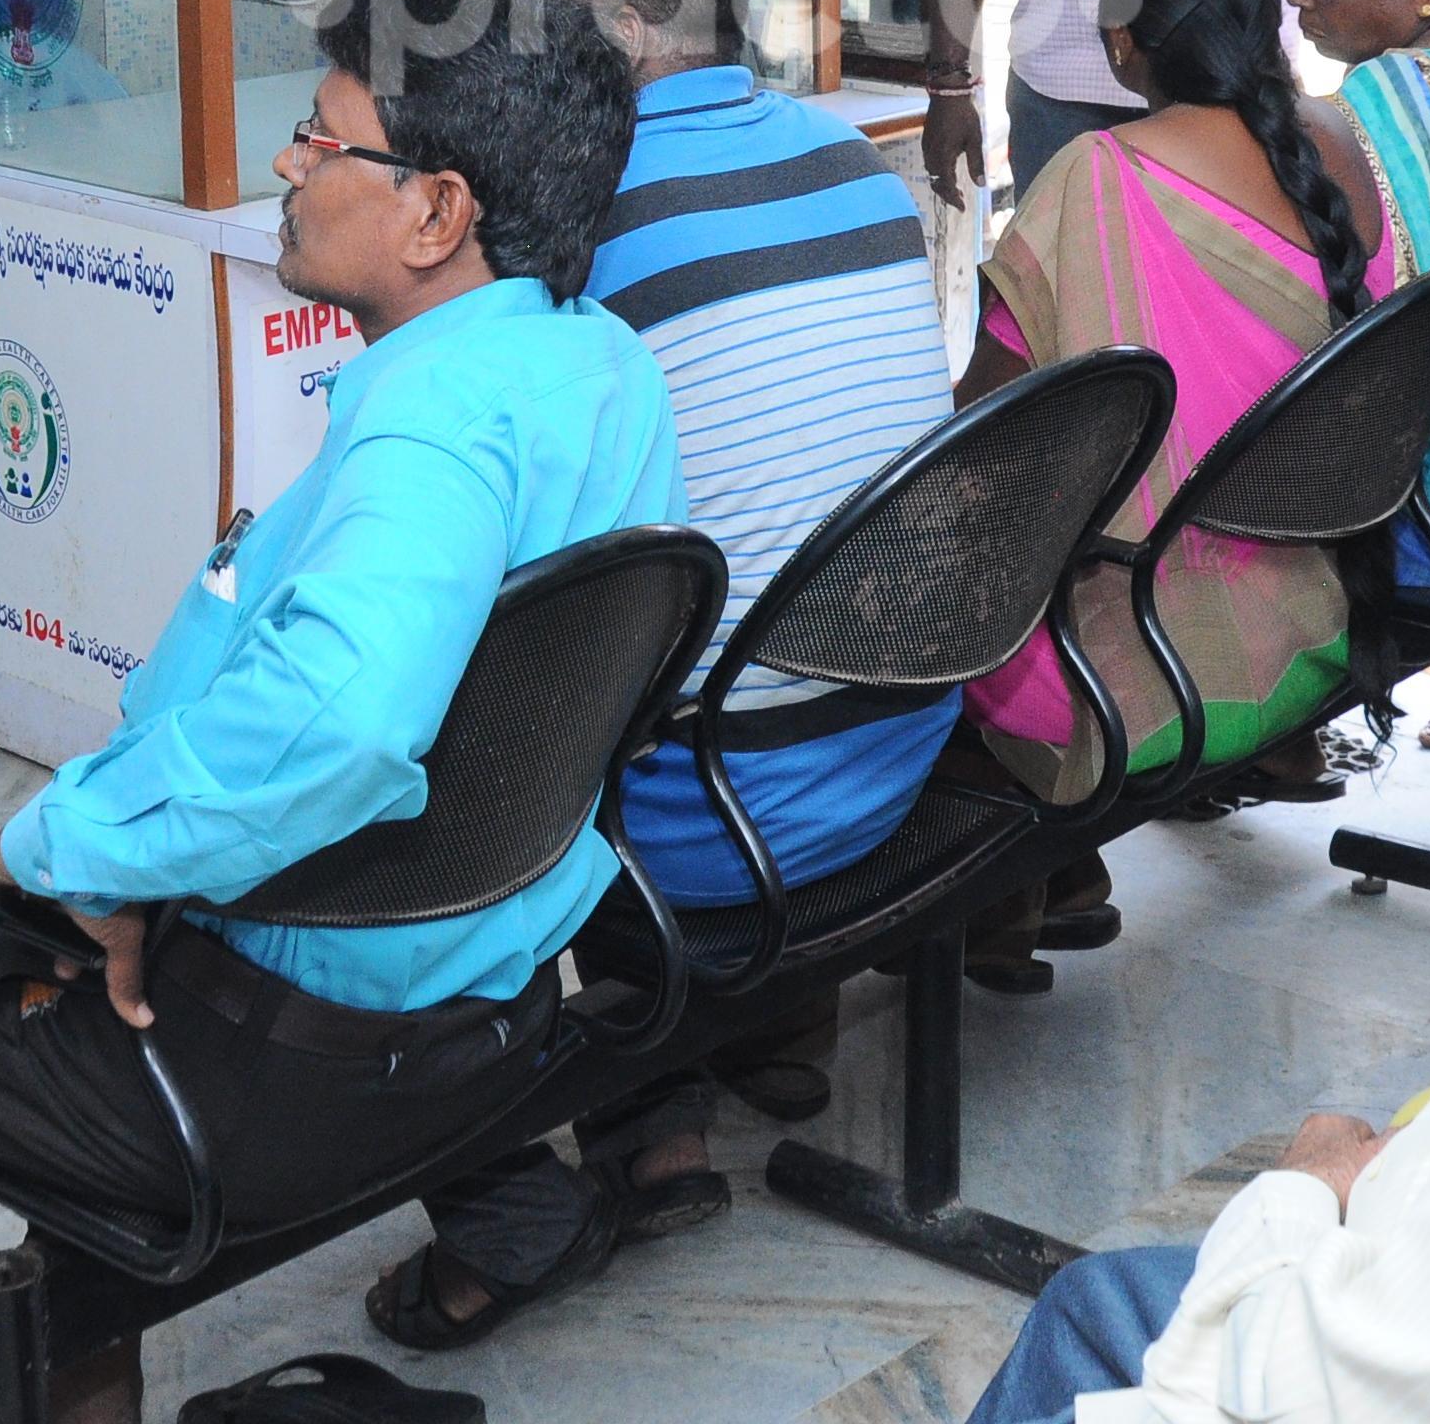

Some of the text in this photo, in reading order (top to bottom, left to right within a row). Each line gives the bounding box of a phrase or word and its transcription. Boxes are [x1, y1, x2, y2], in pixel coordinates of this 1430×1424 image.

[33, 360, 56, 396] CARE
[53, 401, 69, 456] TRUST
[25, 507, 47, 522] CARE
[47, 490, 61, 511] FOR
[24, 608, 65, 649] 104
